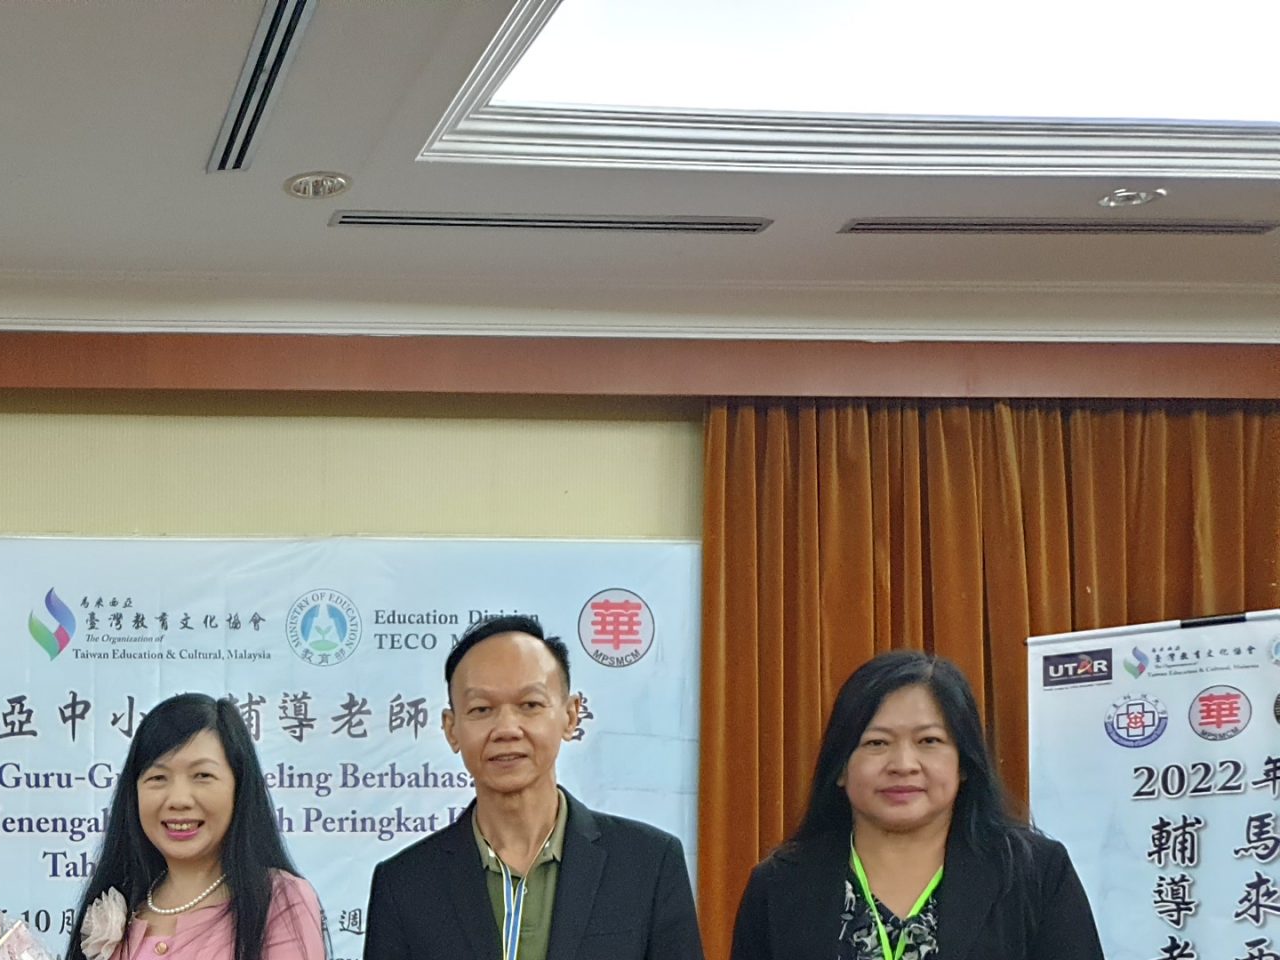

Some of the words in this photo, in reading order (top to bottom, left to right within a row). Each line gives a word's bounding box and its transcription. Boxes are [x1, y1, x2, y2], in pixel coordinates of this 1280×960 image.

[289, 597, 311, 649] MINISTRY
[311, 592, 327, 602] OF
[328, 593, 359, 650] EDUCATION
[374, 609, 459, 625] Education
[590, 599, 643, 650] 華
[86, 634, 99, 643] The
[101, 634, 152, 643] Organization
[154, 634, 165, 643] of
[374, 633, 437, 650] TECO
[73, 649, 110, 660] Taiwan
[112, 648, 163, 660] Education
[166, 649, 176, 660] &
[179, 648, 224, 661] Cultural,
[227, 649, 272, 662] Malaysia
[593, 649, 641, 667] MPSMCM
[1049, 660, 1107, 677] UTAR
[1199, 693, 1241, 729] 華
[265, 763, 332, 797] eling
[303, 807, 439, 841] Peringkat
